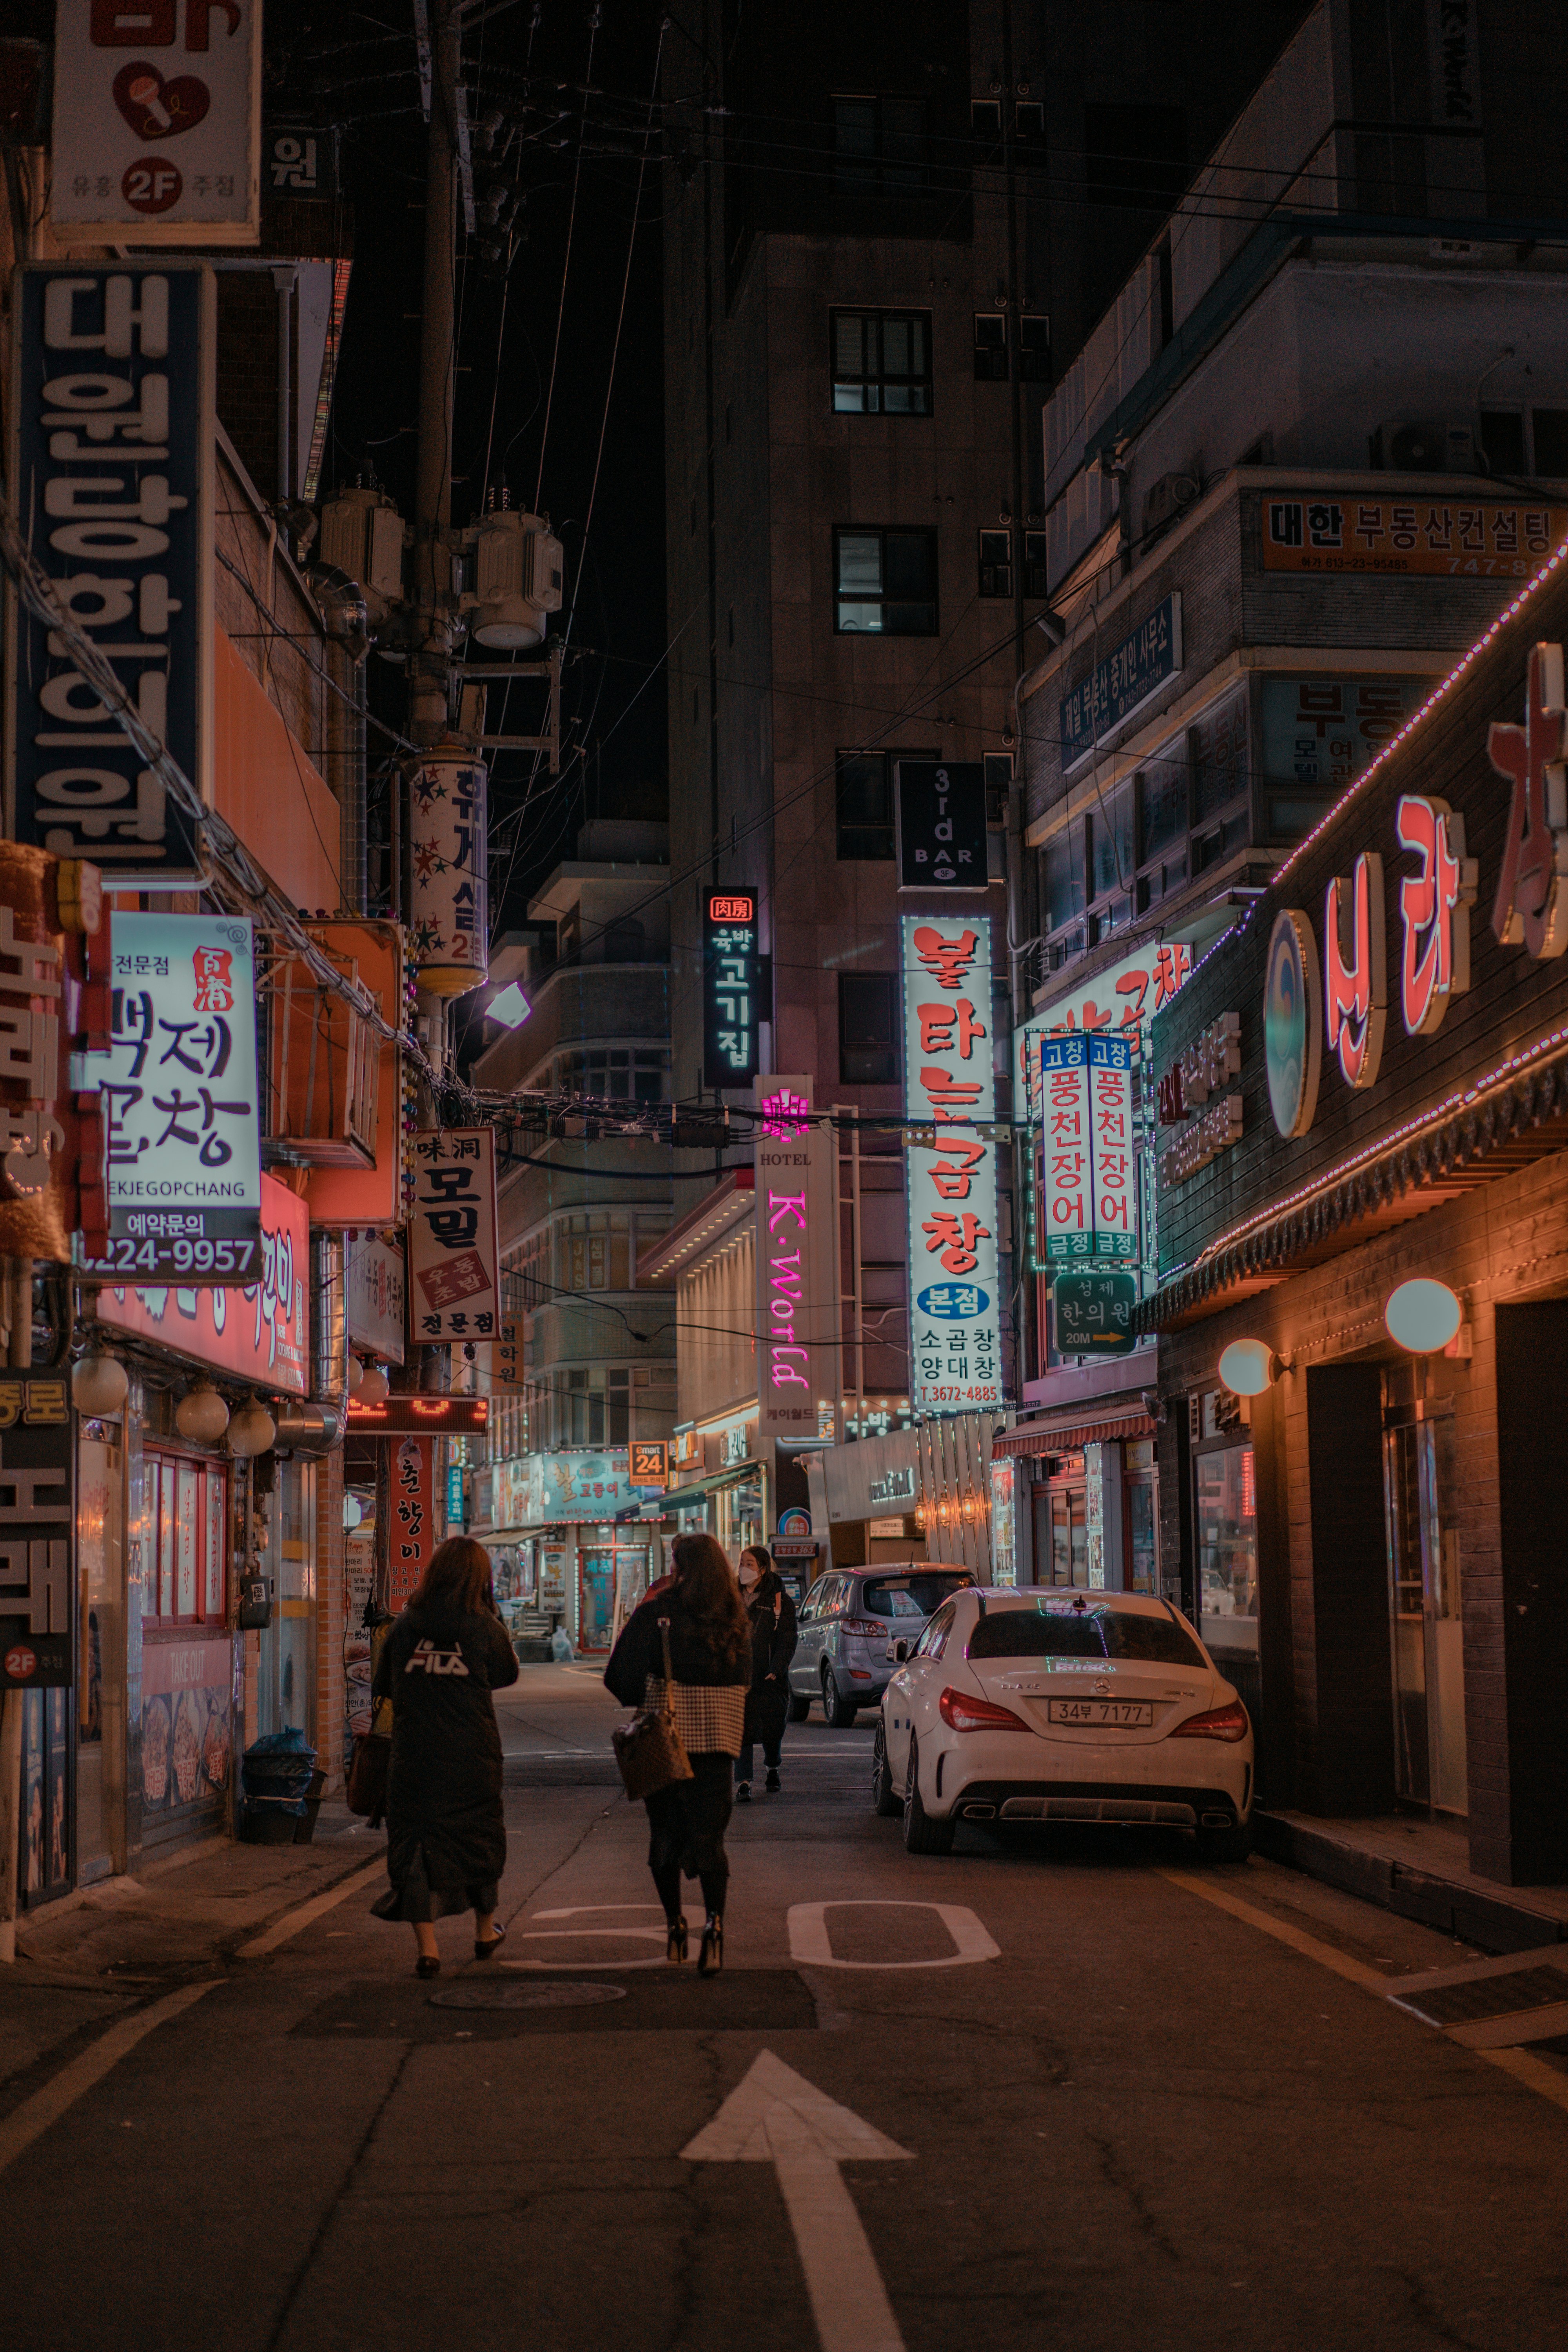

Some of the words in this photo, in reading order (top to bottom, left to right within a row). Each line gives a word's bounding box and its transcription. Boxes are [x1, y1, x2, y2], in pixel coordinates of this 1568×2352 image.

[271, 137, 316, 188] 원
[71, 174, 113, 197] 유흥
[127, 170, 178, 200] 2F
[192, 174, 235, 197] 주점
[1269, 503, 1343, 548] 대한
[1355, 505, 1551, 555] 부동산컨설팅
[1065, 691, 1082, 739] 제일
[1083, 665, 1108, 725] 부동산
[1111, 636, 1137, 700] 중개인
[1139, 609, 1167, 669] 사무소
[915, 849, 973, 863] BAR
[939, 869, 951, 878] 3F
[714, 899, 748, 918] 肉房
[711, 929, 753, 953] 육방
[111, 955, 168, 975] 전문점
[715, 959, 750, 1068] 고기집
[1045, 1041, 1084, 1068] 고창
[1093, 1041, 1127, 1067] 고창
[760, 1153, 812, 1167] HOTEL
[1049, 1070, 1091, 1228] 풍천장어
[1096, 1070, 1129, 1230] 풍천장어
[419, 1167, 481, 1249] 모밀
[127, 1214, 205, 1237] 예약문의
[82, 1239, 254, 1272] 224-9957
[1050, 1234, 1089, 1254] 금정
[1097, 1234, 1132, 1254] 금정
[425, 1256, 476, 1284] 우동
[434, 1274, 482, 1306] 초밥
[1077, 1279, 1114, 1298] 성제
[926, 1287, 979, 1316] 본점
[421, 1312, 493, 1334] 전문점
[1060, 1301, 1129, 1326] 한의원
[919, 1329, 995, 1351] 소곱창
[1065, 1332, 1091, 1344] 20M
[920, 1357, 996, 1380] 양대창
[920, 1386, 998, 1403] T.3672-4885
[766, 1408, 815, 1420] 케이월드
[635, 1445, 661, 1455] emart
[636, 1455, 663, 1473] 24
[580, 1481, 618, 1498] 고등어
[397, 1459, 424, 1559] 춘향이
[586, 1560, 610, 1573] 제주
[592, 1577, 607, 1625] 해산물
[6, 1651, 33, 1671] 2F
[171, 1651, 189, 1684] TAKE
[190, 1650, 205, 1682] OUT
[405, 1655, 470, 1677] FILA
[1059, 1704, 1092, 1720] 34부
[1100, 1705, 1143, 1721] 7177
